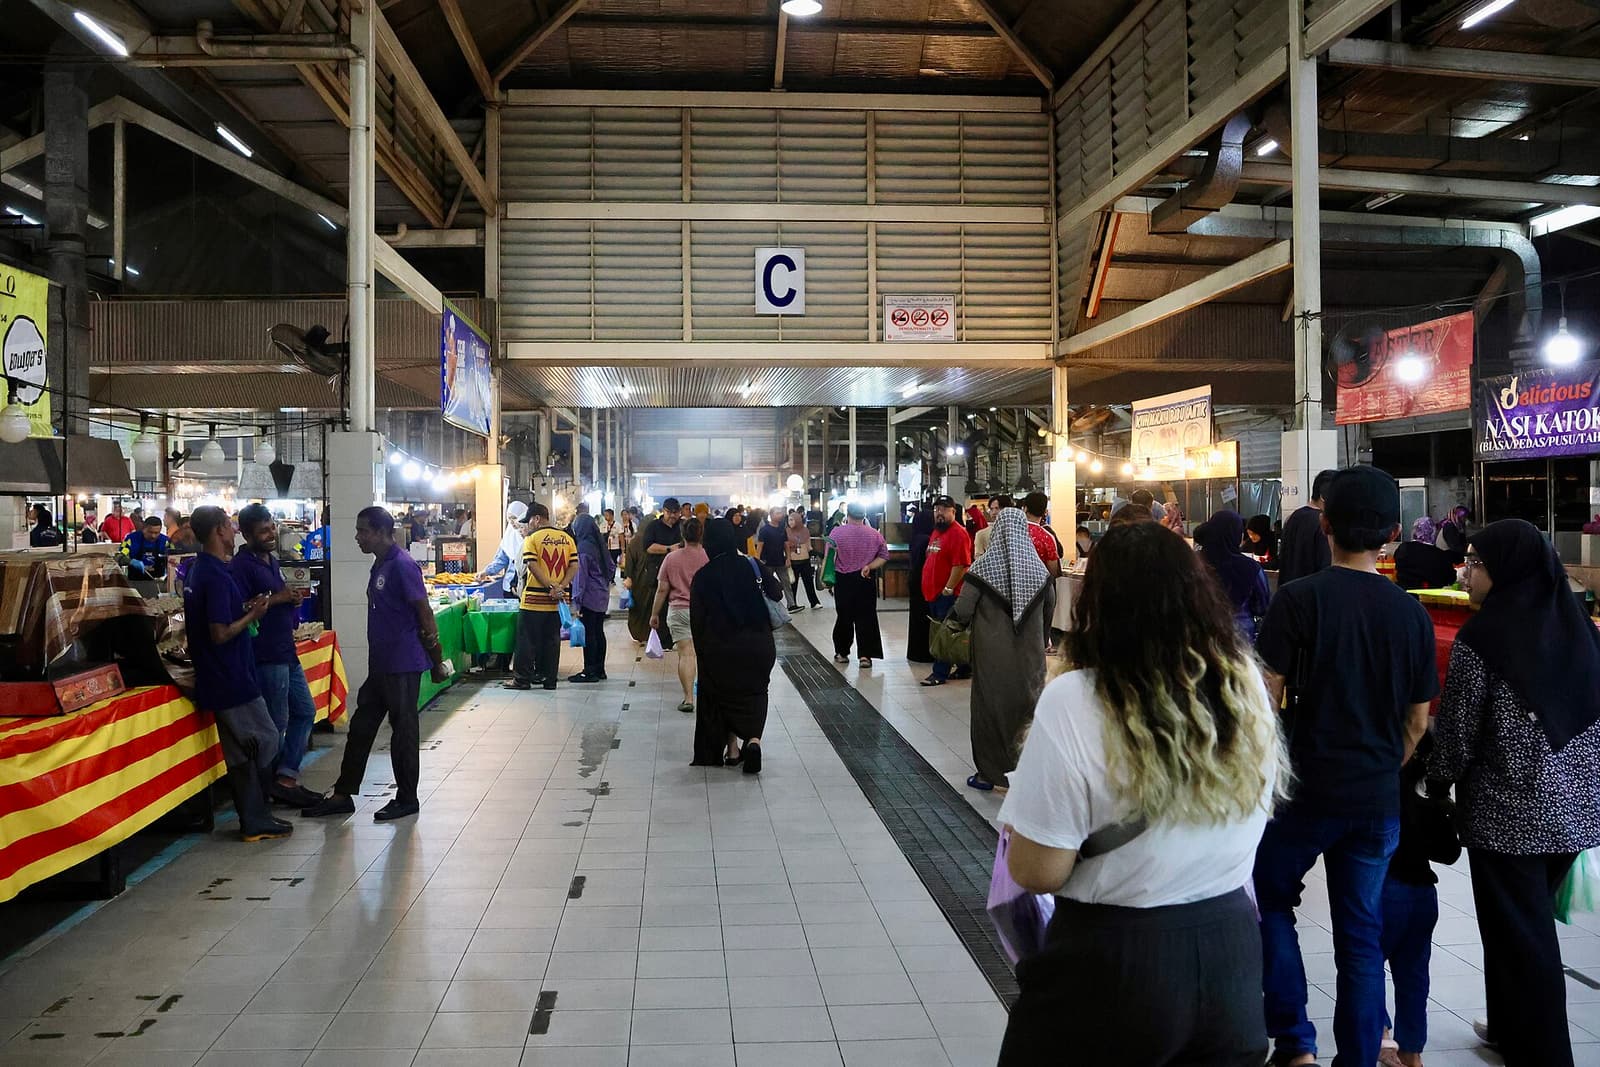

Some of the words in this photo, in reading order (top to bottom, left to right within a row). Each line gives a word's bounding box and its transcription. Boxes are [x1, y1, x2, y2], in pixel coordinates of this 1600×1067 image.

[763, 254, 797, 308] C
[1484, 415, 1532, 440] NASI
[1535, 406, 1600, 435] KATOK
